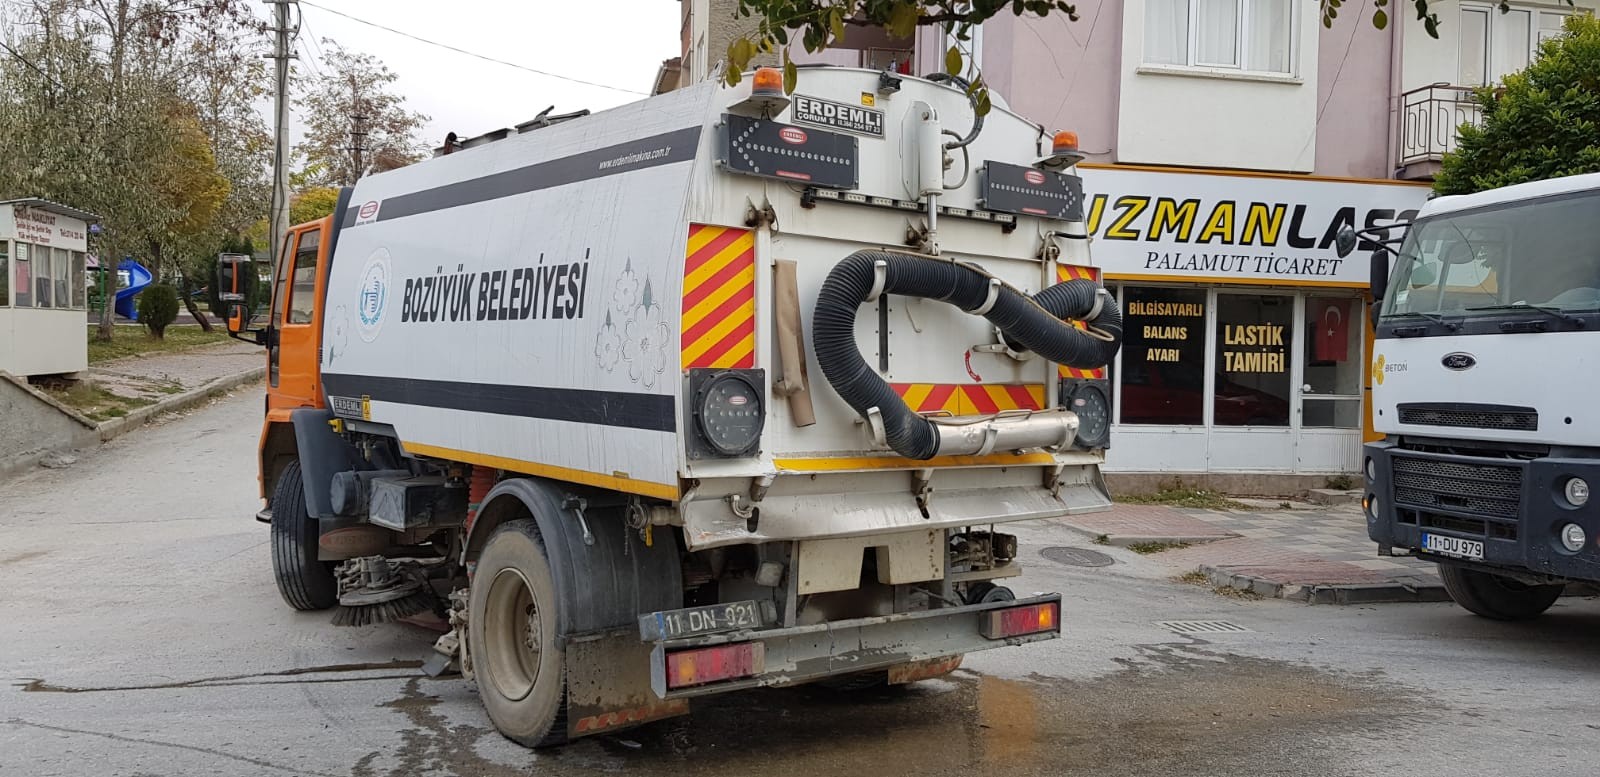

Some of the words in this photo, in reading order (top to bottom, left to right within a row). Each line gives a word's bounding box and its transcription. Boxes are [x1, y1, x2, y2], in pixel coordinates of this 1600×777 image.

[798, 112, 827, 123] ÇORUM
[1143, 251, 1250, 273] PALAMUT
[1253, 252, 1343, 276] TİCARET
[401, 263, 476, 323] BOZÜYÜK
[476, 247, 591, 321] BELEDİYESİ
[1128, 299, 1203, 317] BİLGİSAYARLI
[1143, 325, 1188, 340] BALANS
[1224, 322, 1284, 346] LASTİK
[1146, 348, 1180, 362] AYARI
[1224, 348, 1285, 373] TAMİRİ
[1385, 363, 1408, 373] BETON
[1428, 535, 1438, 549] 11
[1443, 538, 1459, 552] DU
[1461, 541, 1482, 556] 979
[665, 613, 682, 635] 11
[689, 609, 717, 632] DN
[724, 604, 754, 626] 921
